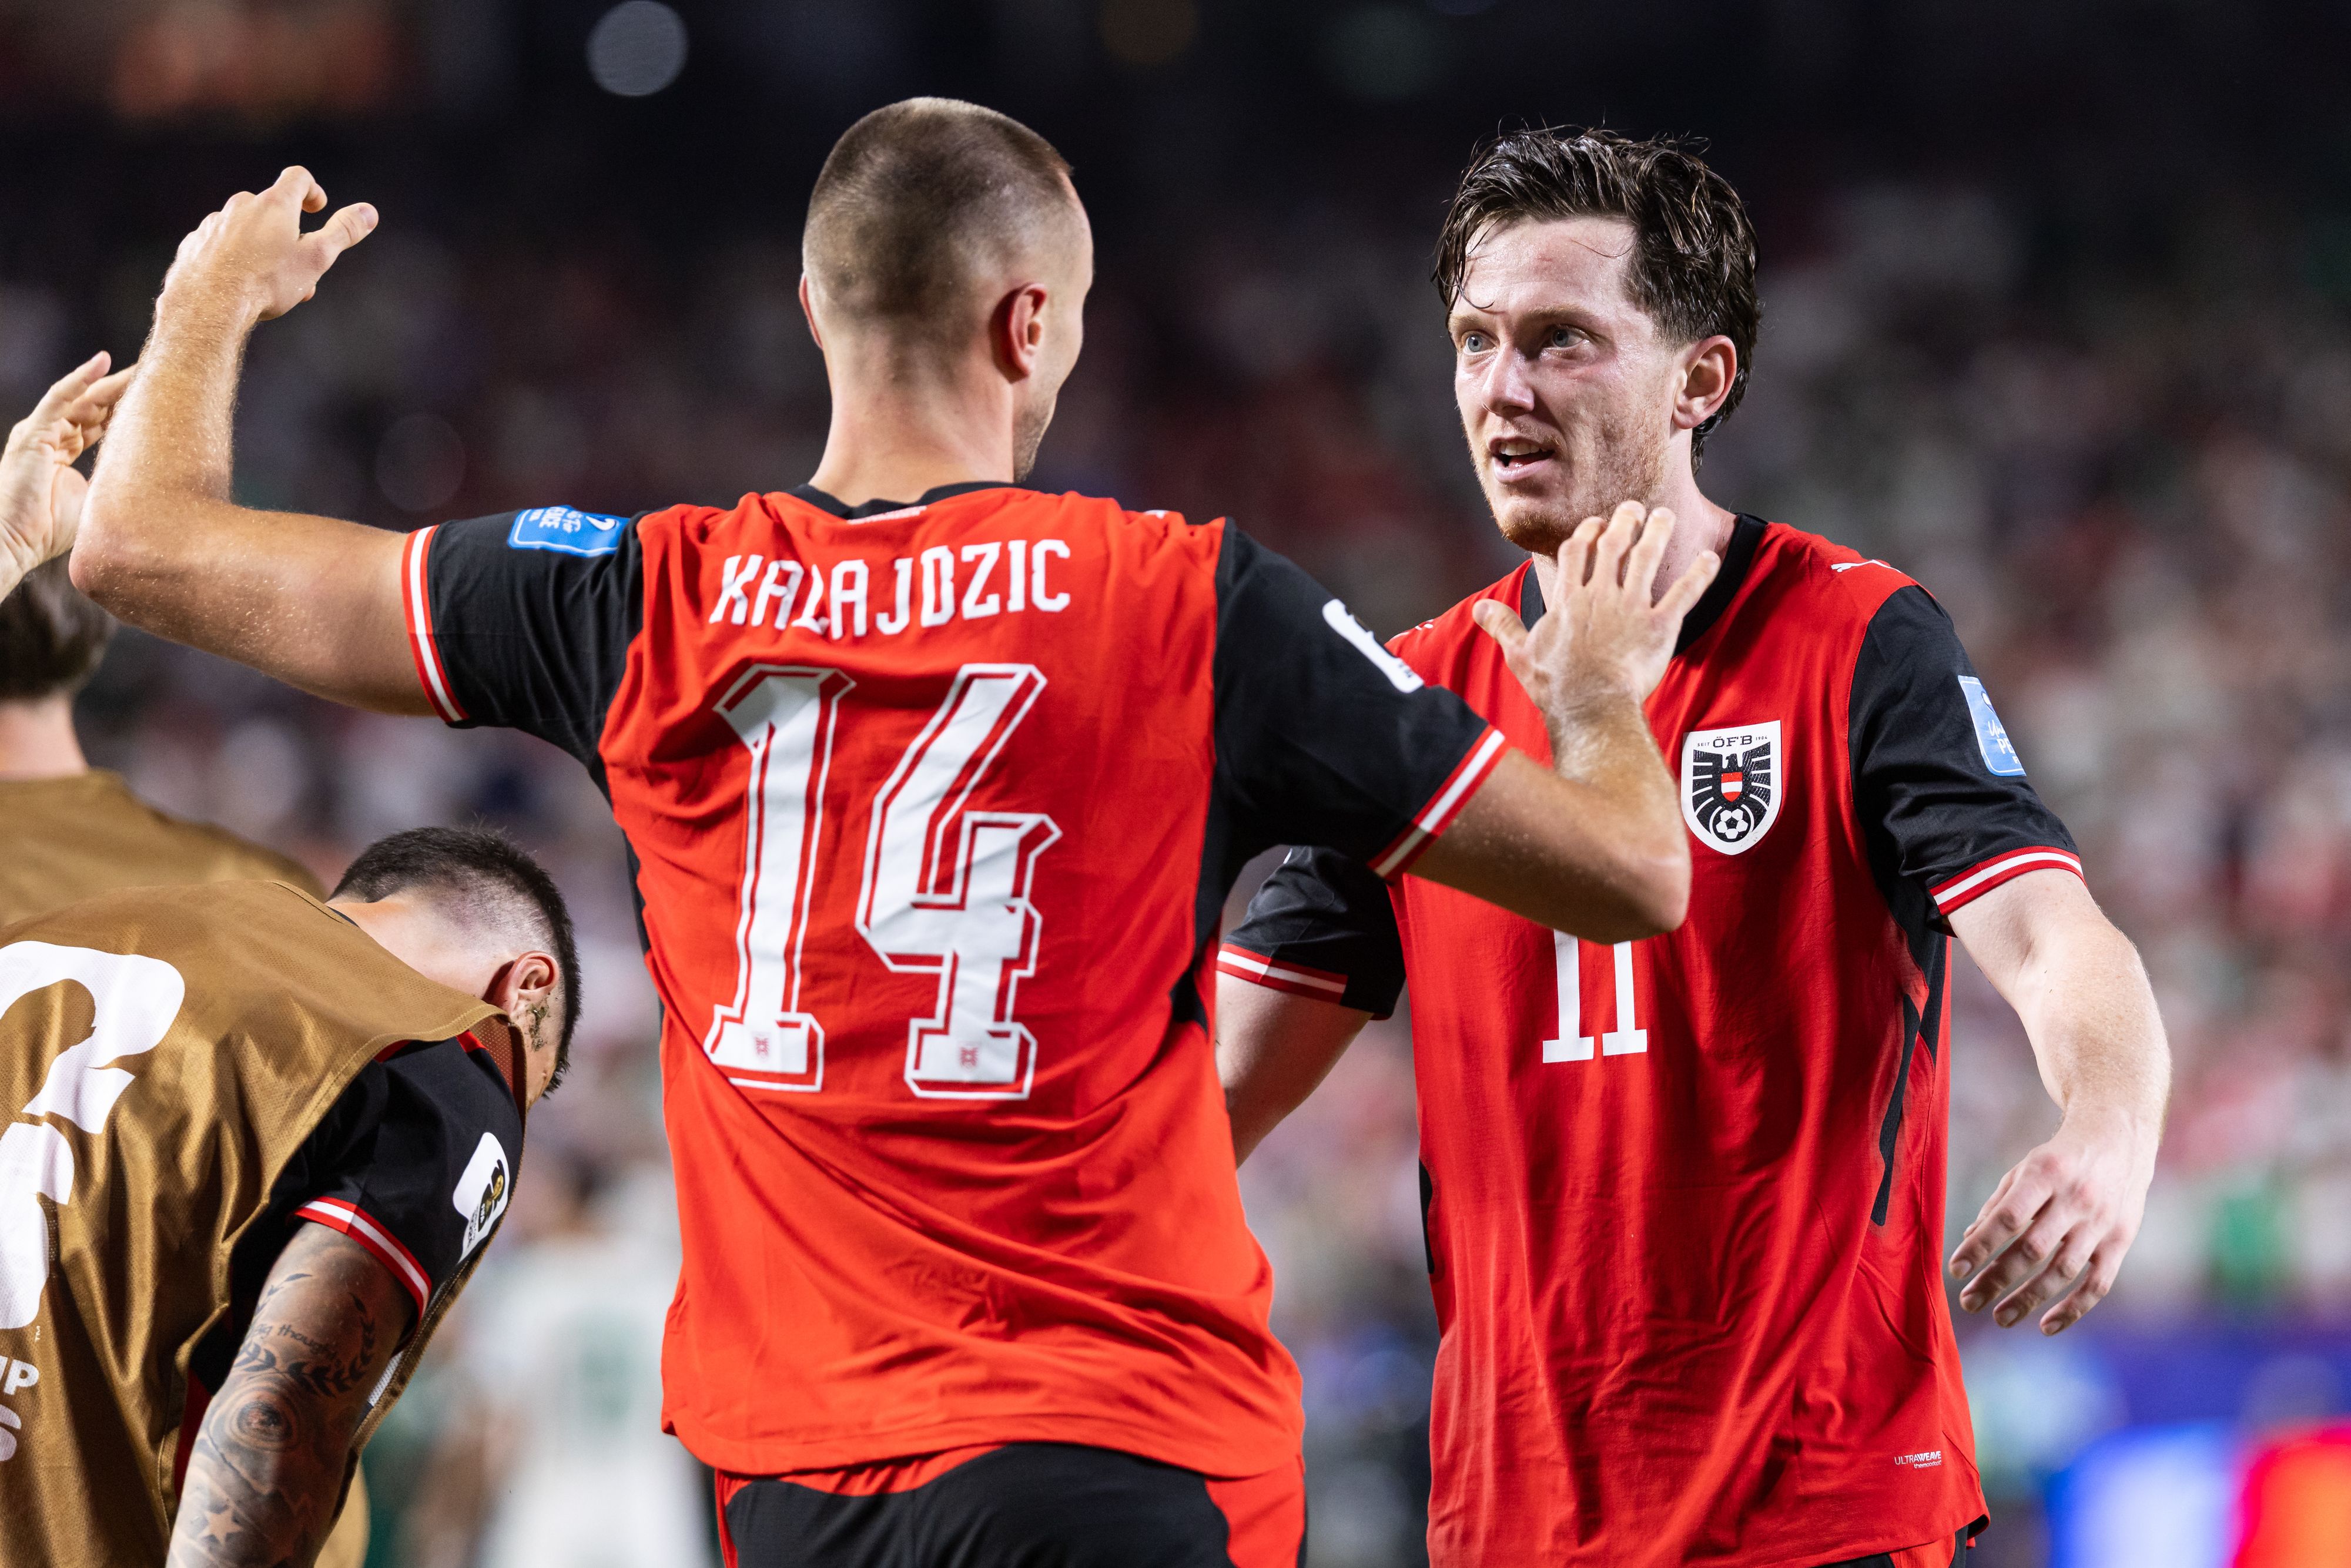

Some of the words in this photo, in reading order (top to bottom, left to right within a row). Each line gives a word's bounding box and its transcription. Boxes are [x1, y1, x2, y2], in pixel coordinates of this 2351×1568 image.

[709, 540, 1070, 640] KALAJDZIC
[1713, 735, 1753, 748] ÖFB
[704, 663, 1063, 1100] 14
[1542, 928, 1647, 1064] 11
[1894, 1450, 1942, 1466] ULTRAWEAVE
